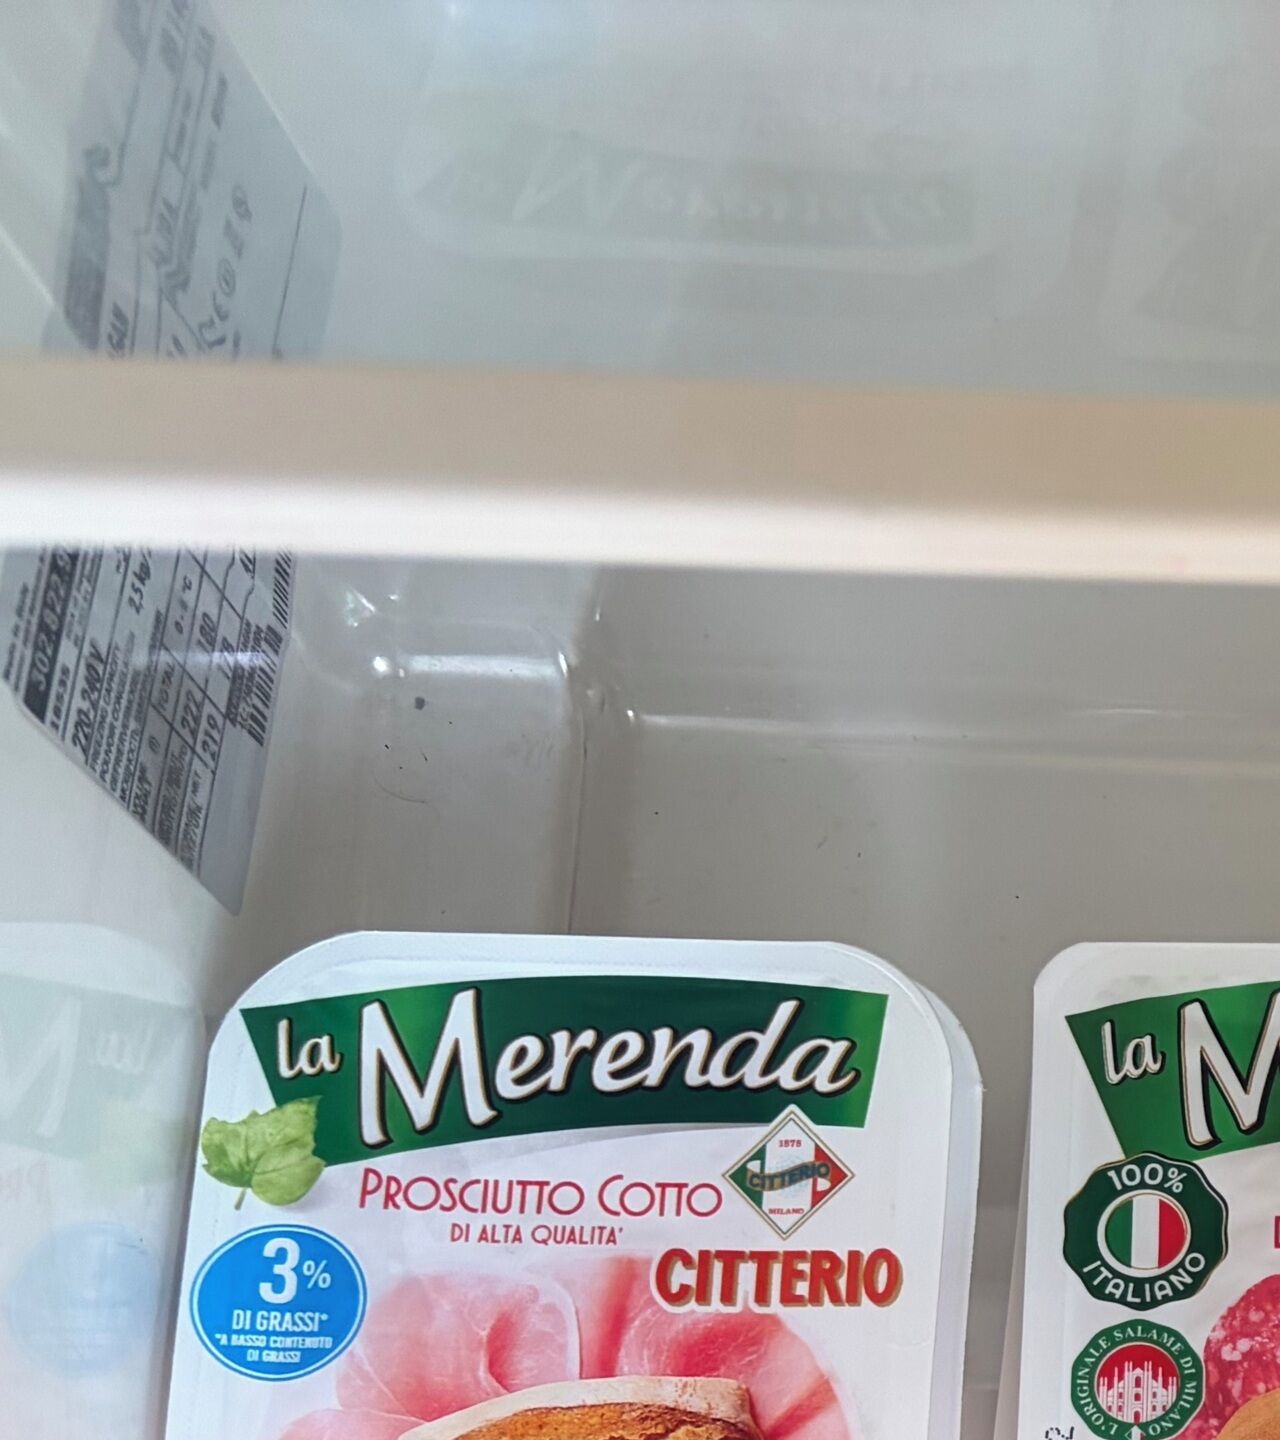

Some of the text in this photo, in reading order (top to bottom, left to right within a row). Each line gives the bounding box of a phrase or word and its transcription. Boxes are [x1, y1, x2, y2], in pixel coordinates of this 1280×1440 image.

[275, 987, 860, 1148] la Merenda
[1100, 1018, 1163, 1087] la
[358, 1167, 724, 1218] PROSCIUTTO COTTO
[1106, 1162, 1188, 1194] 100%
[450, 1224, 624, 1247] DI ALTA QUALITA'
[656, 1248, 905, 1309] CITTERIO
[1082, 1251, 1206, 1304] ITALIANO
[232, 1309, 251, 1331] DI
[1075, 1324, 1199, 1438] L'ORIGINALE SALAME DI MILANO
